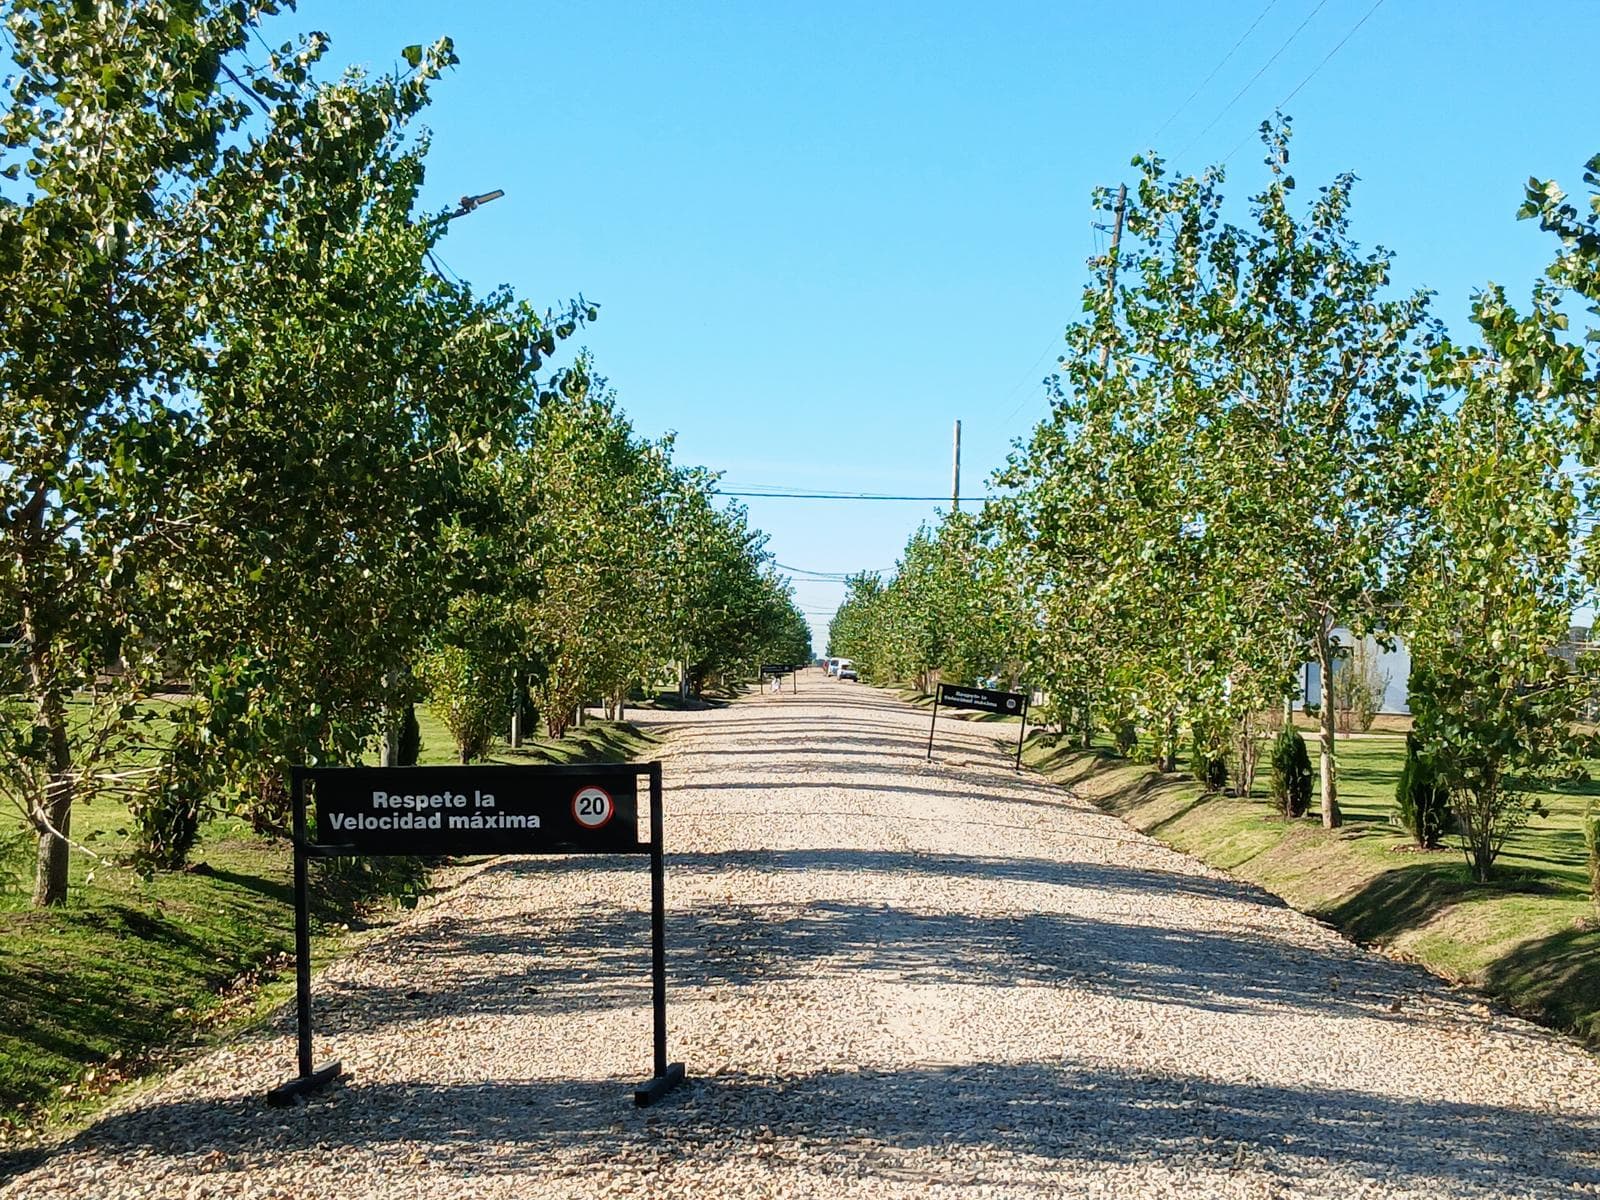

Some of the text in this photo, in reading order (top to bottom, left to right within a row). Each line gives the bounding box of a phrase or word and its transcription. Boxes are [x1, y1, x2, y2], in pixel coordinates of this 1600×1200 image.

[372, 790, 495, 811] Respete la
[578, 796, 604, 817] 20
[329, 810, 541, 830] Velocidad máxima
